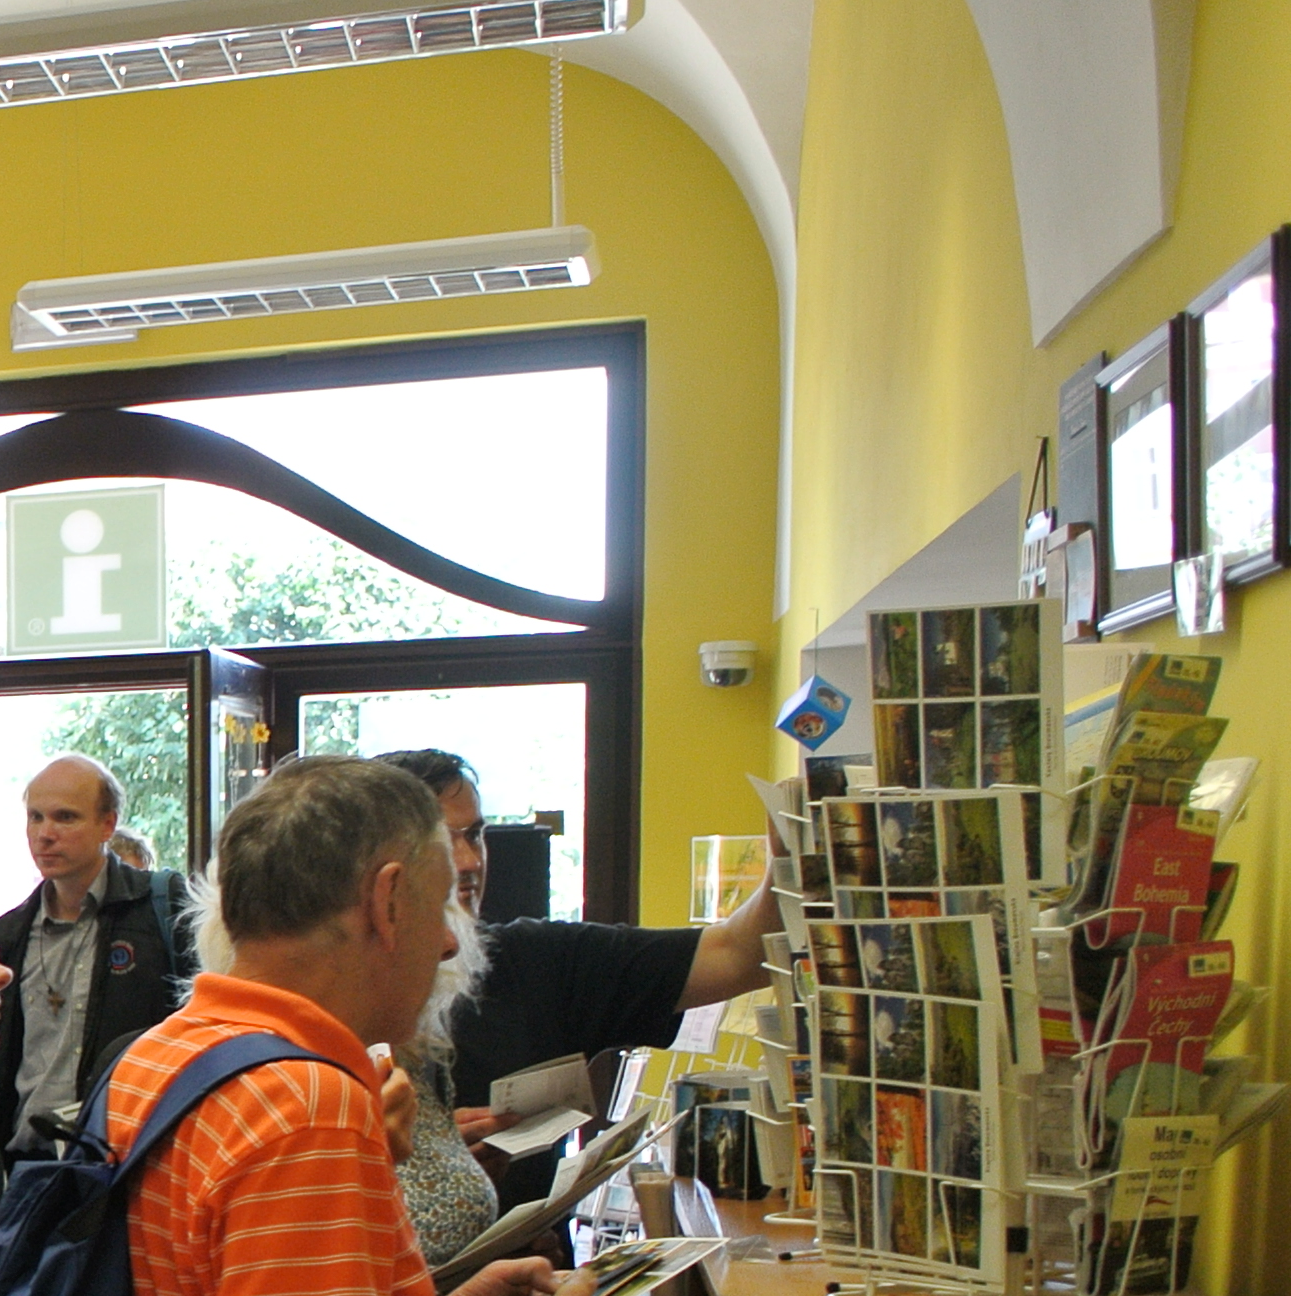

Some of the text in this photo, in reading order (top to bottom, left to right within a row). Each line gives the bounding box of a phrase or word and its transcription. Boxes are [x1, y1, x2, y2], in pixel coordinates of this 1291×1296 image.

[1153, 857, 1181, 877] East
[1132, 883, 1190, 903] Bohemia
[1148, 990, 1218, 1017] Východní
[1147, 1015, 1196, 1037] Čechy
